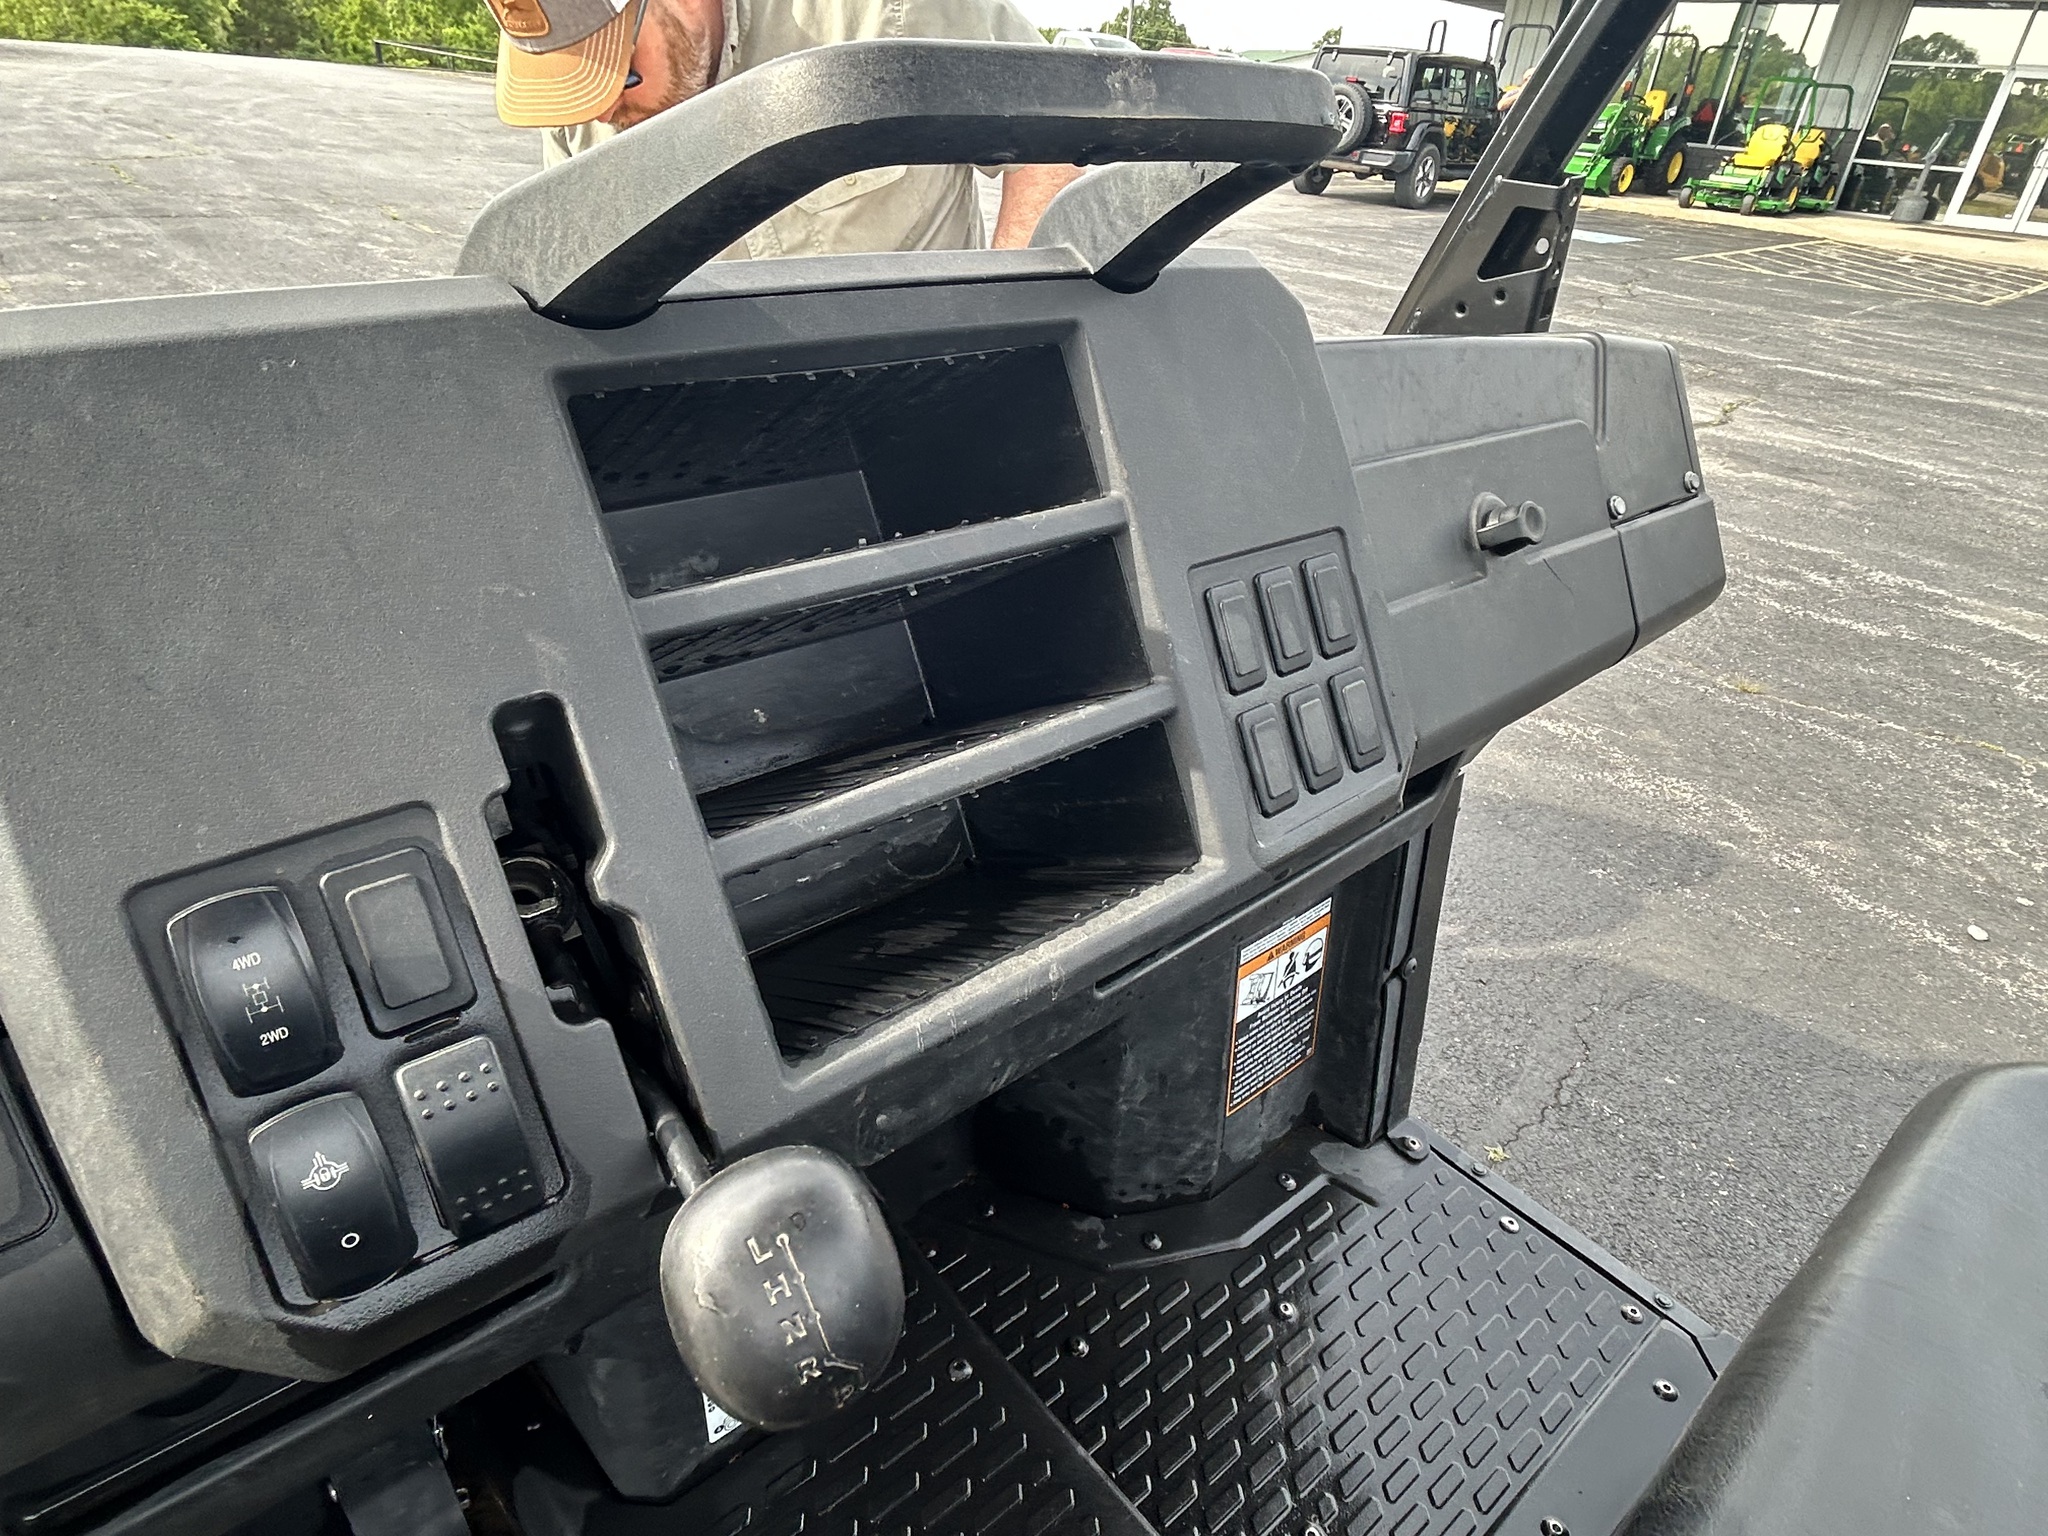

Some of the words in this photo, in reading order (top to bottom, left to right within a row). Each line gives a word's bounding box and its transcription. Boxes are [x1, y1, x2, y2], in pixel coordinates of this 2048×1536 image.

[231, 951, 262, 972] 4WD
[259, 1026, 290, 1048] 2WD
[746, 1236, 774, 1265] L
[762, 1272, 793, 1307] H
[779, 1311, 808, 1346] N
[795, 1356, 822, 1385] R
